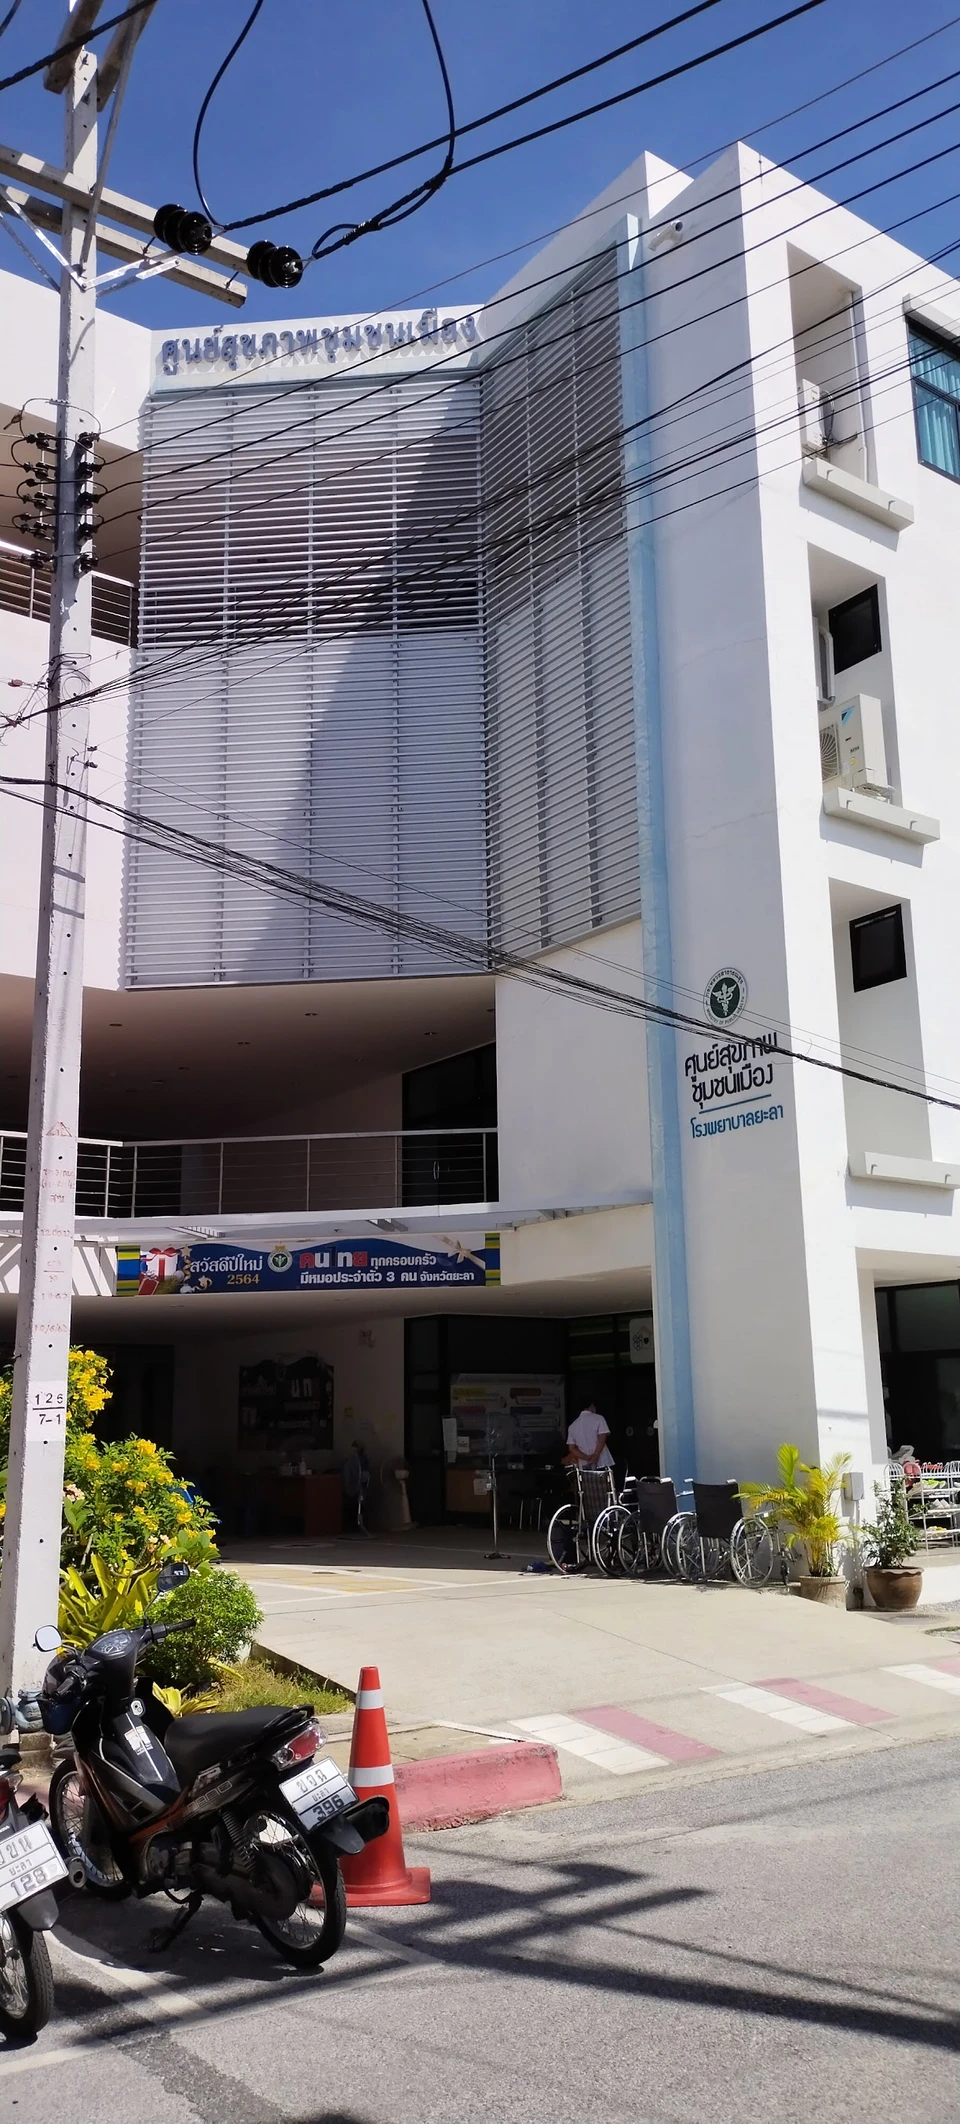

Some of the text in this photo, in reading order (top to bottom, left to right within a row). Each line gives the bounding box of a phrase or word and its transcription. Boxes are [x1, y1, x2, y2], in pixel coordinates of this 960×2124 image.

[161, 308, 477, 376] ศูนย์สุขภาพชุมชนเมือง
[685, 1032, 778, 1082] ศูนย์สุขภาพ
[692, 1063, 773, 1110] ชุมชนเมือง
[690, 1104, 784, 1139] โรงพยาบาลยะลา
[190, 1253, 263, 1273] สวัสดีปีใหม่
[300, 1245, 437, 1270] คนไทย ทุกครอบครัว
[226, 1273, 261, 1285] 2564
[300, 1270, 475, 1284] มีหมอประจำตัว 3 คน จังหวัดยะลา
[312, 1788, 330, 1802] ยะลา
[312, 1794, 344, 1822] 396
[9, 1859, 32, 1876] ยะลา
[11, 1867, 48, 1896] 128
